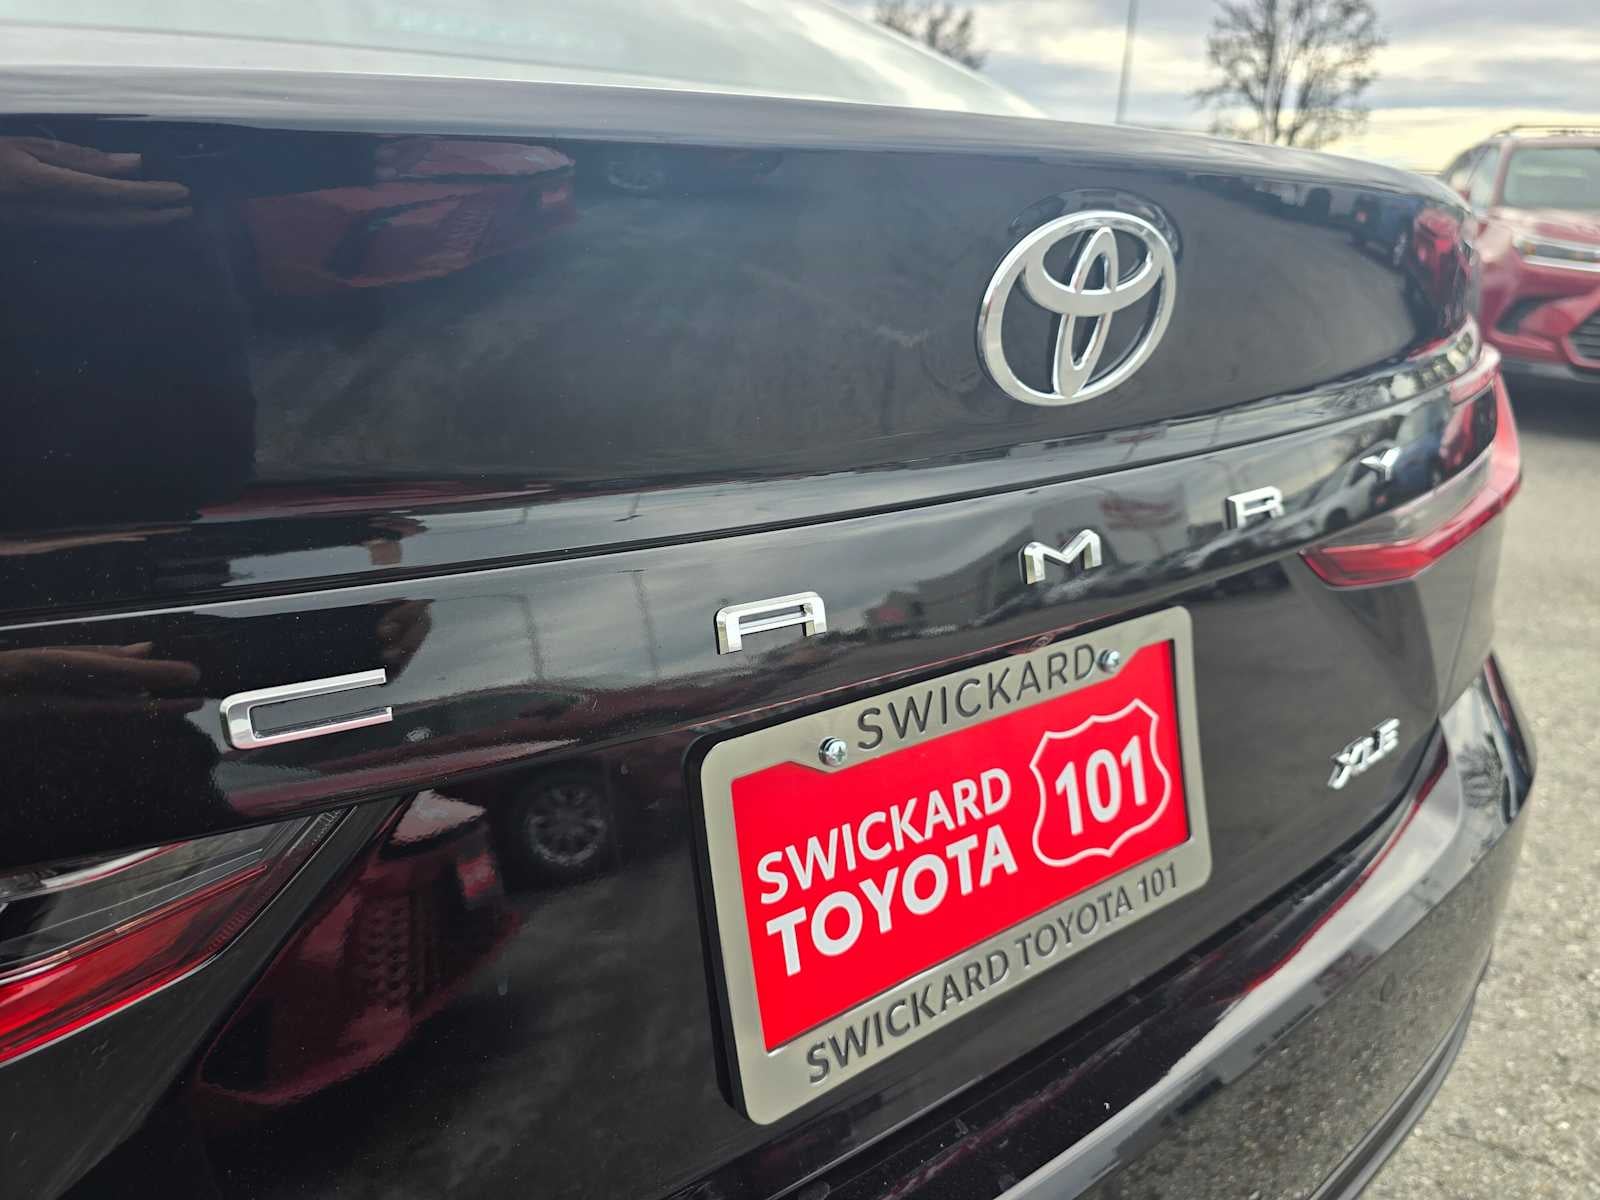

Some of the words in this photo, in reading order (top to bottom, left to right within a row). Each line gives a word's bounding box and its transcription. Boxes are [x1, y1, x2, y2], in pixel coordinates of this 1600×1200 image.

[220, 448, 1402, 749] CAMRY
[857, 645, 1095, 751] SWICKARD
[1328, 718, 1400, 789] XLE
[757, 768, 1012, 904] SWICKARD
[1055, 736, 1148, 835] 101
[766, 825, 1018, 977] TOYOTA
[807, 949, 1010, 1083] SWICKARD
[1018, 886, 1133, 969] TOYOTA
[1137, 862, 1178, 903] 101
